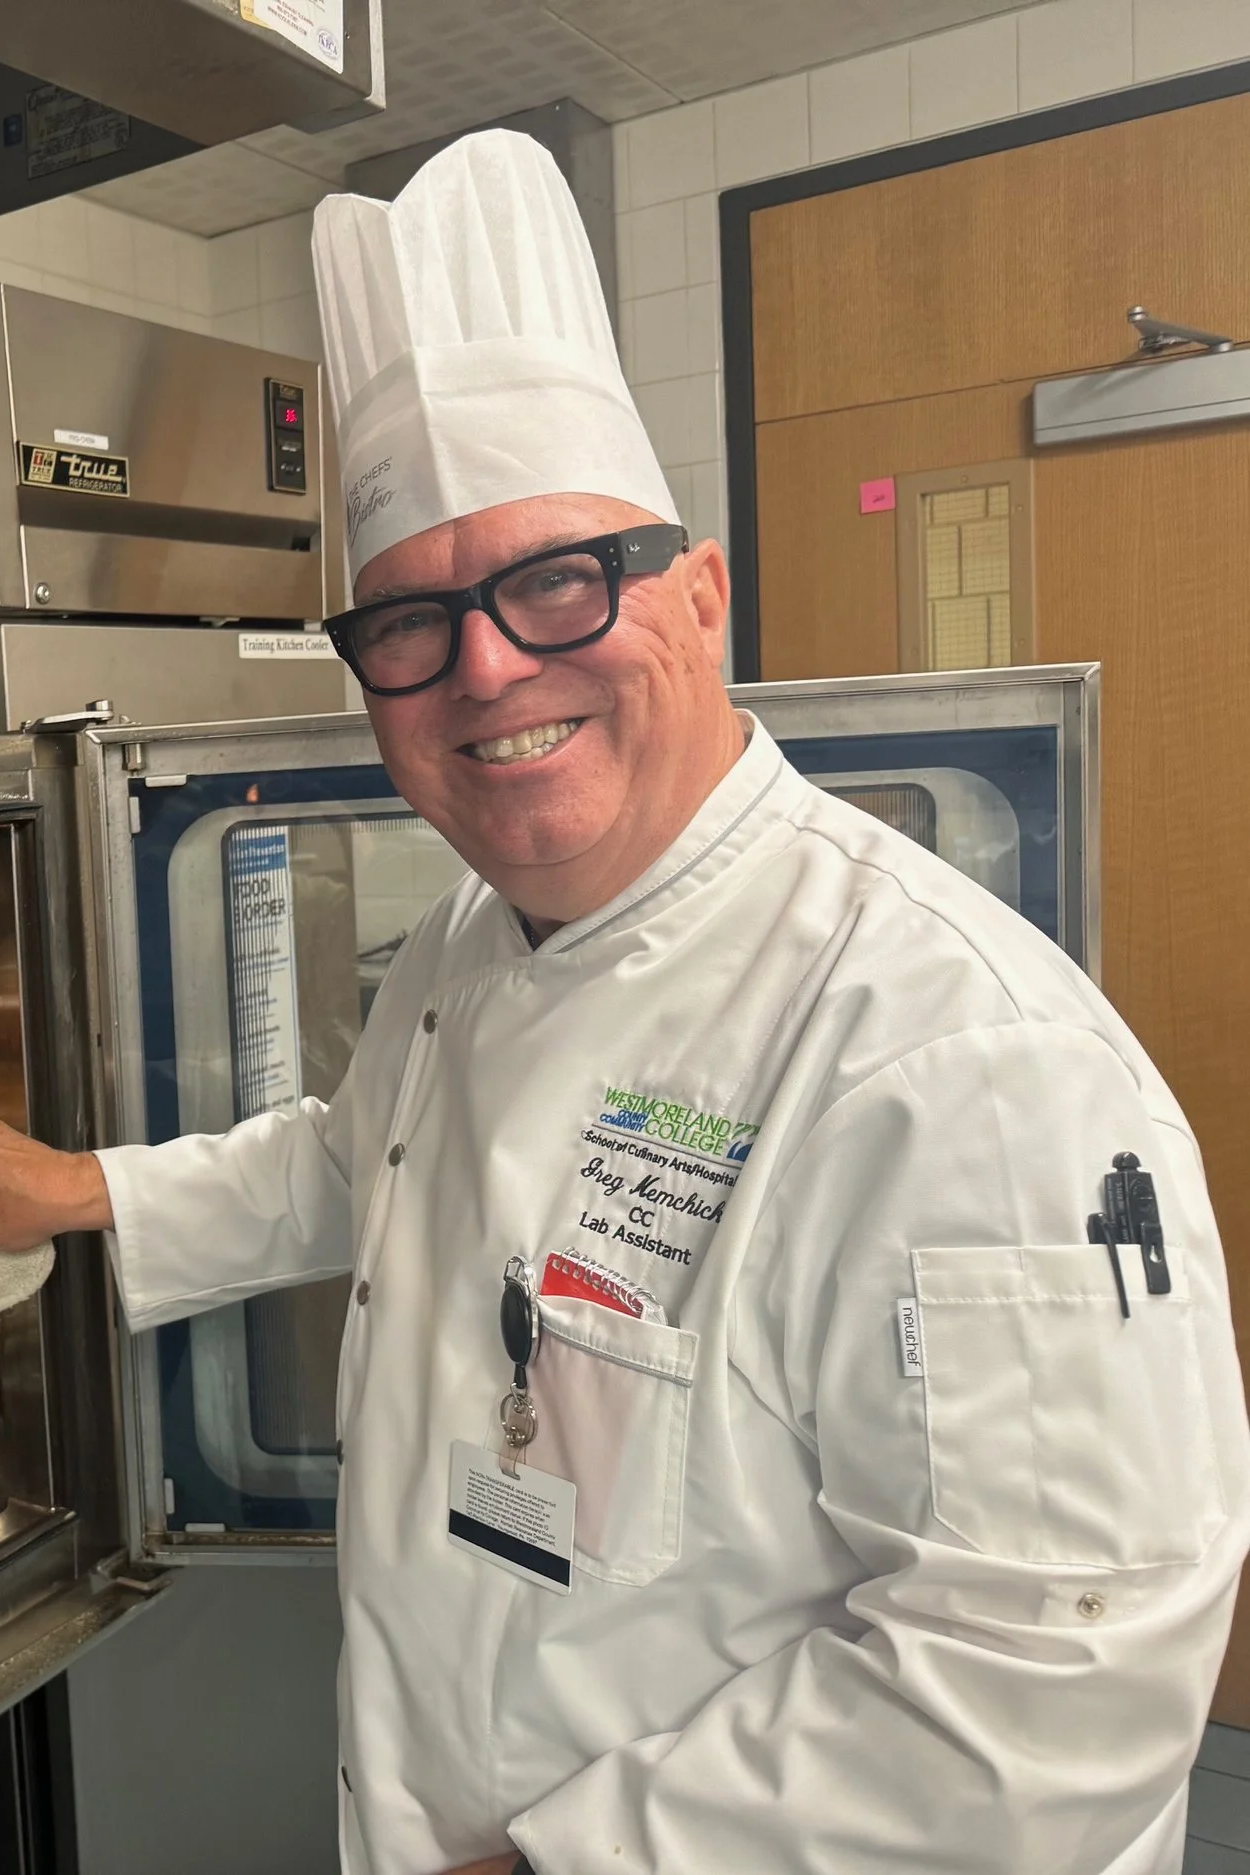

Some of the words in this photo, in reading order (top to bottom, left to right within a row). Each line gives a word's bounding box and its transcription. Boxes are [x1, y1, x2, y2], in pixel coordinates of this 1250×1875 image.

[61, 454, 123, 483] true
[69, 477, 123, 493] REFRIGERATOR
[243, 638, 275, 654] Training
[276, 638, 304, 651] Kitchen
[305, 638, 329, 651] Cooler
[599, 1112, 646, 1133] COMMUNITY
[604, 1086, 732, 1138] WESTMORELAND
[618, 1108, 650, 1124] COUNTY
[583, 1130, 617, 1151] School
[616, 1142, 628, 1152] of
[628, 1144, 669, 1168] Culinary
[644, 1118, 727, 1157] COLLEGE
[580, 1157, 625, 1197] Greg
[628, 1205, 655, 1228] CC
[579, 1211, 609, 1235] Lab
[612, 1224, 692, 1266] Assistant
[902, 1307, 922, 1367] newchef
